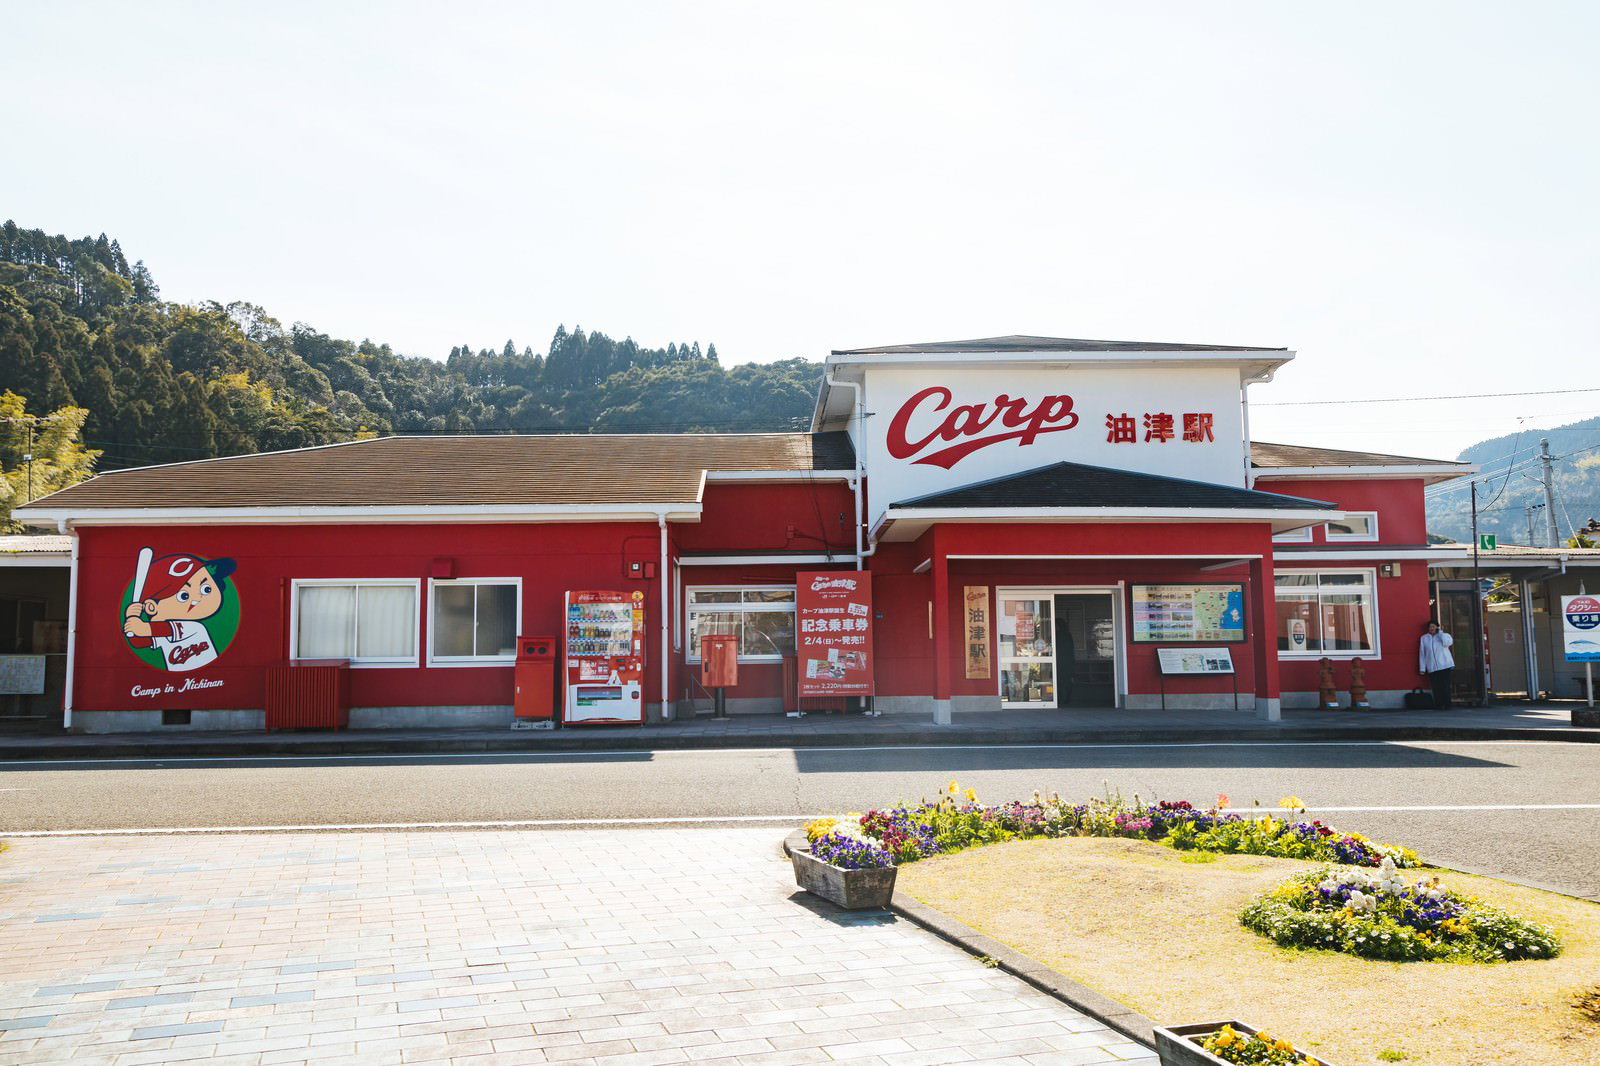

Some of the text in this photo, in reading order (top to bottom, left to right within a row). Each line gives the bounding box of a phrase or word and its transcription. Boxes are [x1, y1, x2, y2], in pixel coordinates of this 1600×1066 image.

[886, 386, 1079, 470] Carp
[1105, 412, 1215, 443] 油津駅
[1569, 604, 1599, 612] タクシー
[801, 618, 869, 632] 記念乗車券
[968, 608, 986, 658] 油津駅
[168, 641, 210, 665] Carp
[164, 683, 175, 693] in
[178, 678, 224, 693] Nichinan
